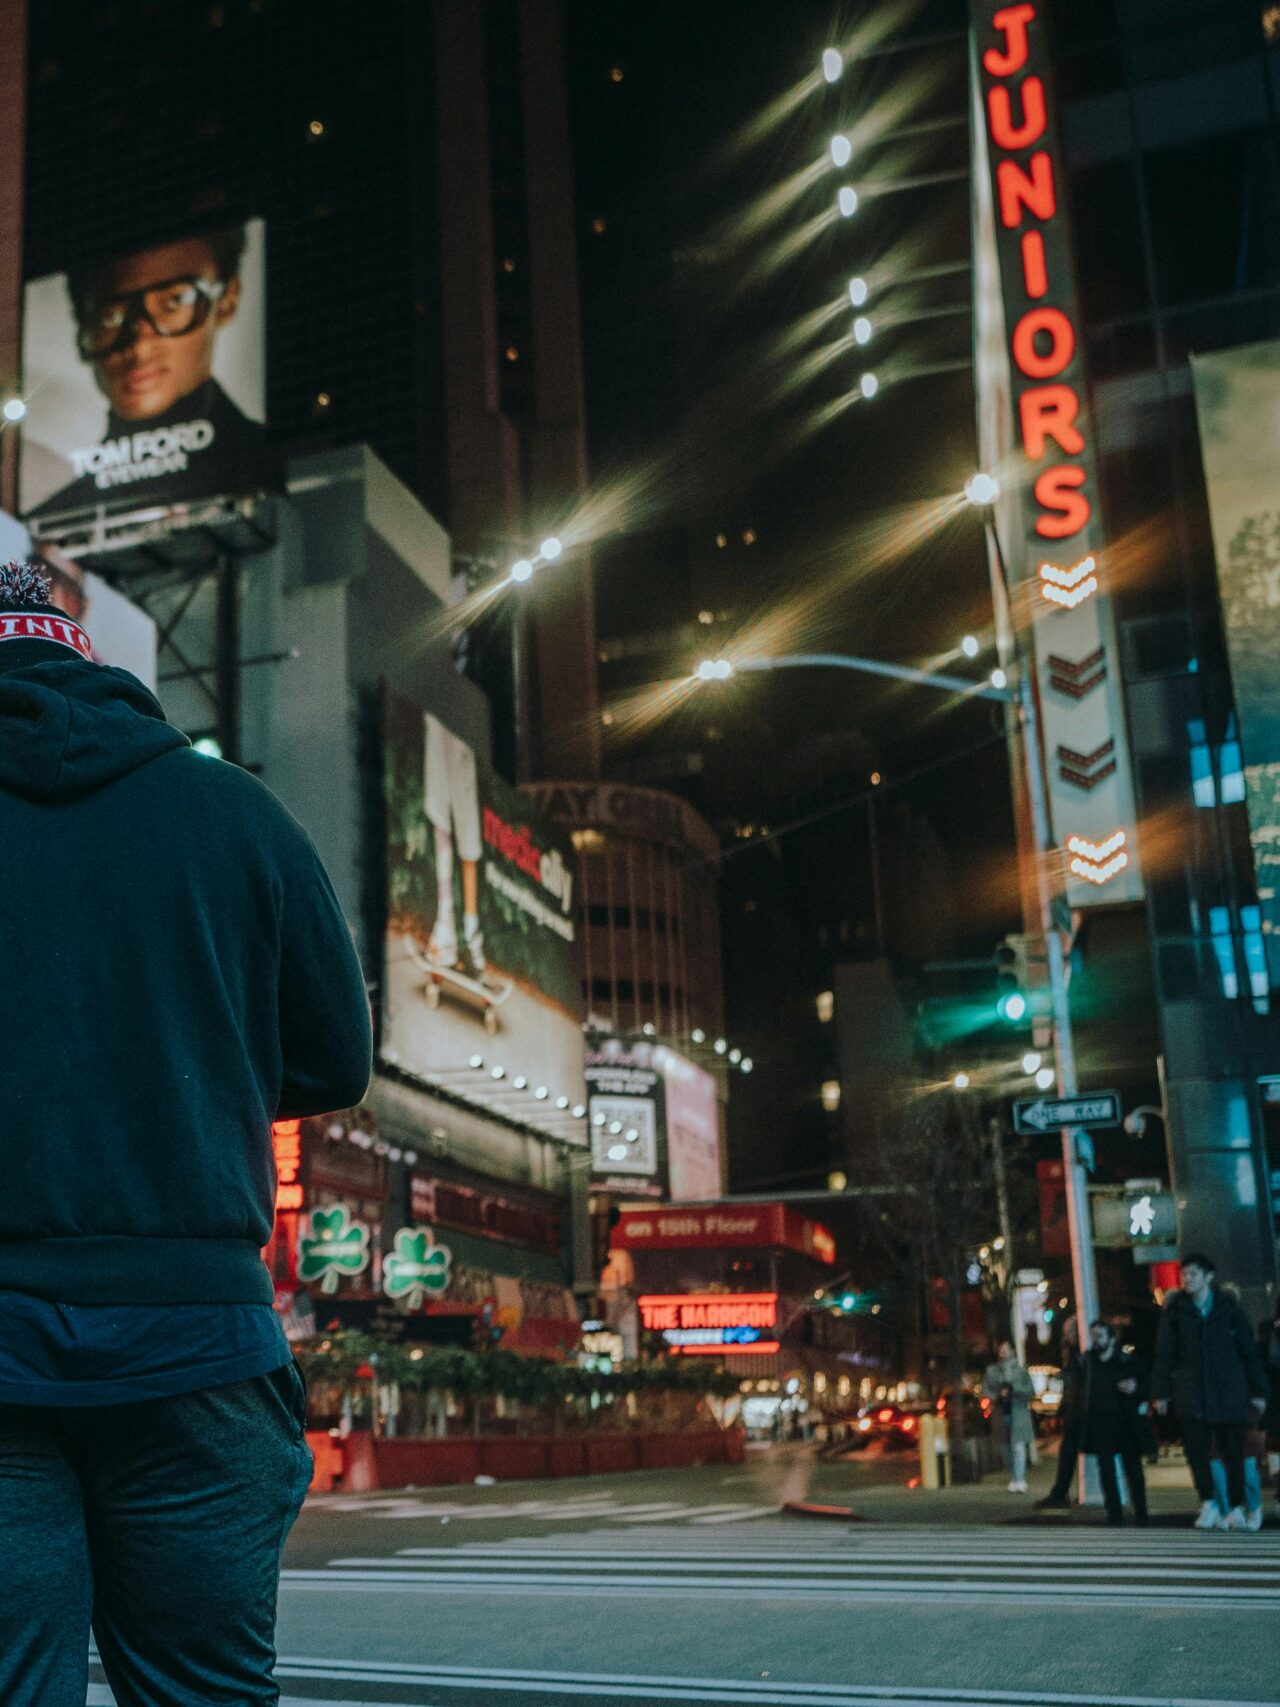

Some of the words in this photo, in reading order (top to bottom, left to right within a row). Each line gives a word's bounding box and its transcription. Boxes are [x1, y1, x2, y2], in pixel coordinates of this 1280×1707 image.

[984, 5, 1090, 540] JUNIORS
[70, 434, 131, 478] TOM
[132, 418, 215, 463] FORD
[1031, 1107, 1058, 1122] ONE
[1076, 1103, 1106, 1120] WAY
[704, 1215, 758, 1234] Floor
[641, 1305, 679, 1329] THE
